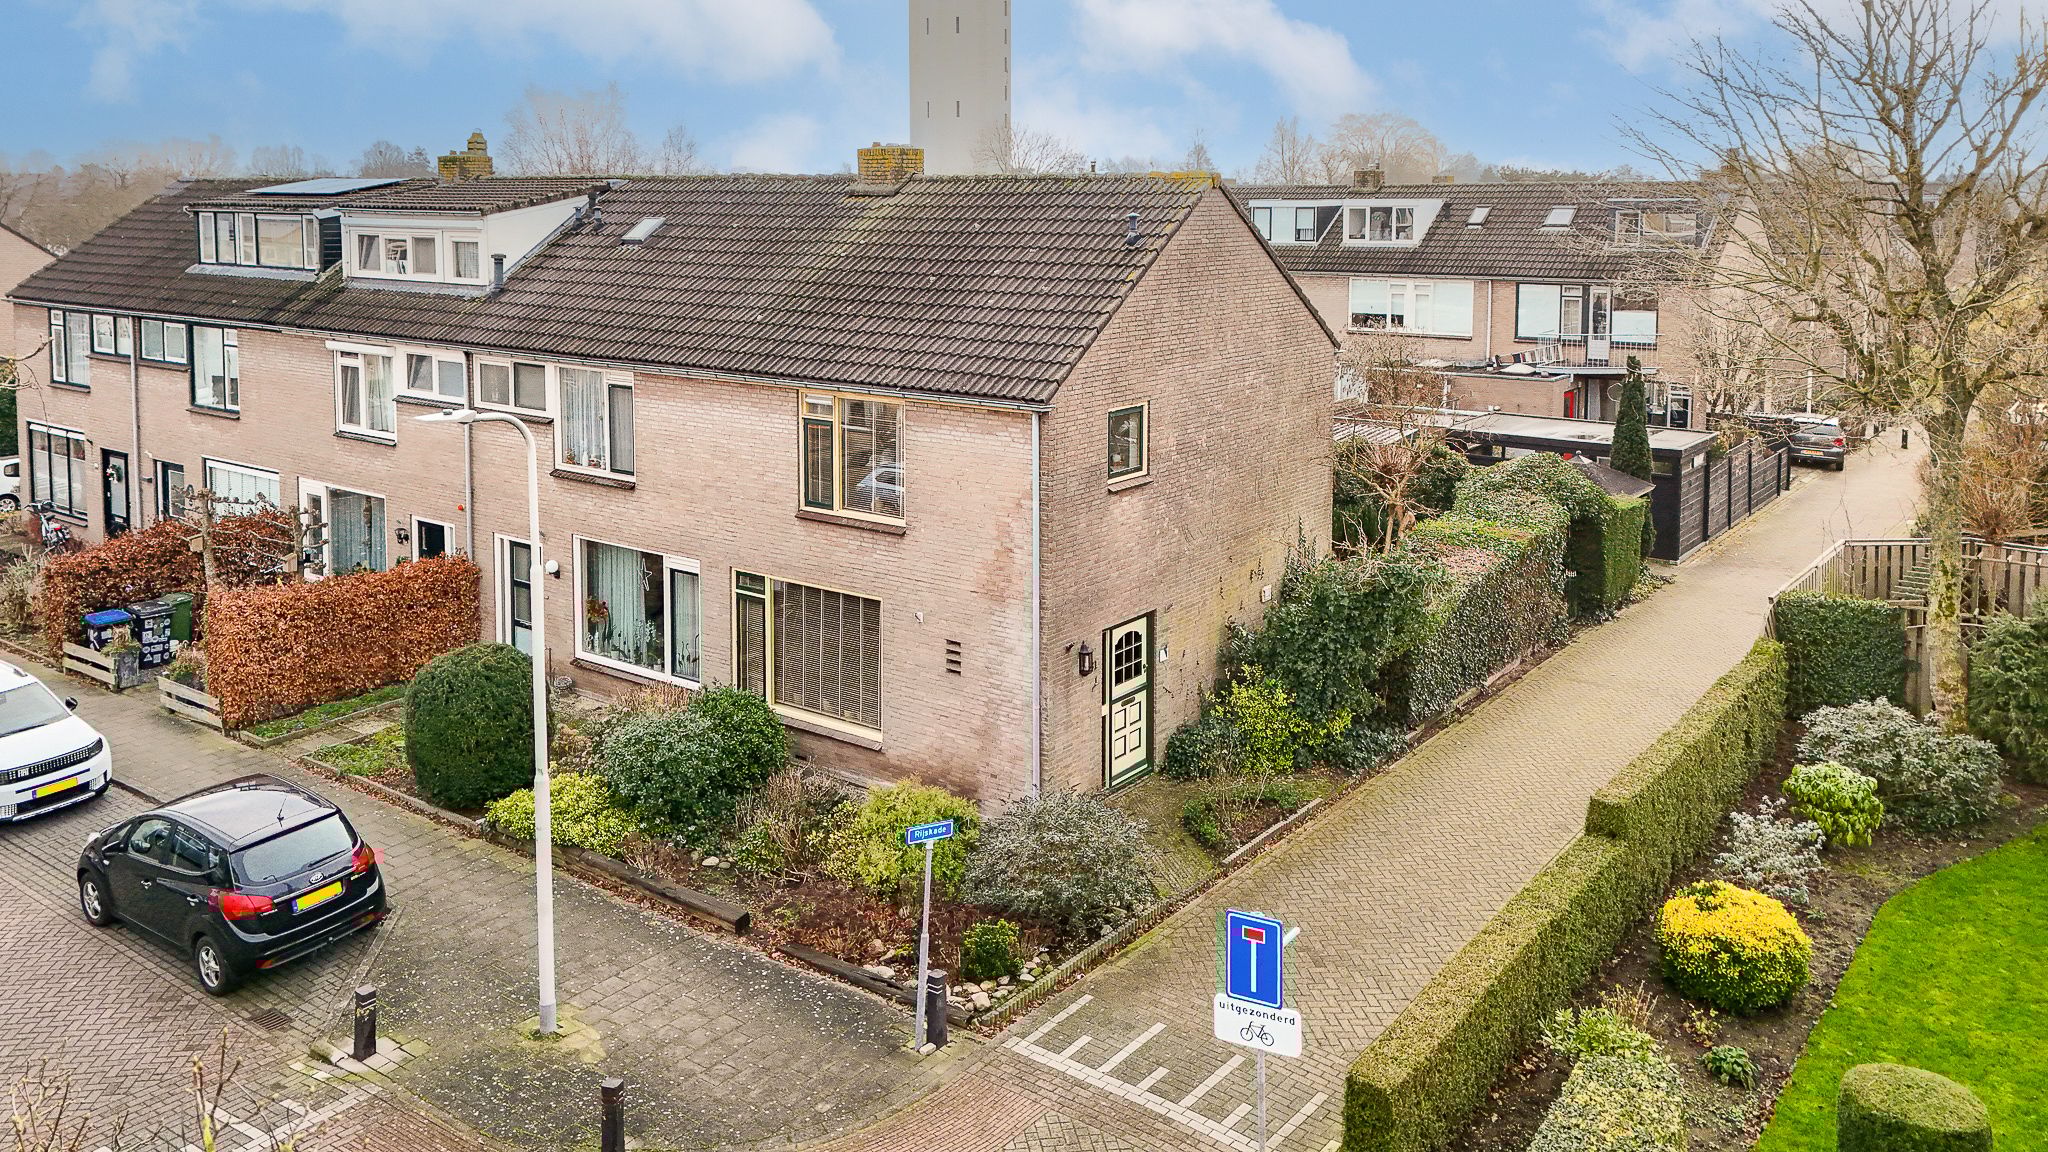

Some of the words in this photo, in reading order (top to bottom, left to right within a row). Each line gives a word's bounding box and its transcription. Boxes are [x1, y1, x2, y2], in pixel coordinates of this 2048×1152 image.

[17, 768, 29, 778] FIAT
[914, 826, 947, 839] Rijskade
[1219, 1001, 1296, 1026] uitgezonderd
